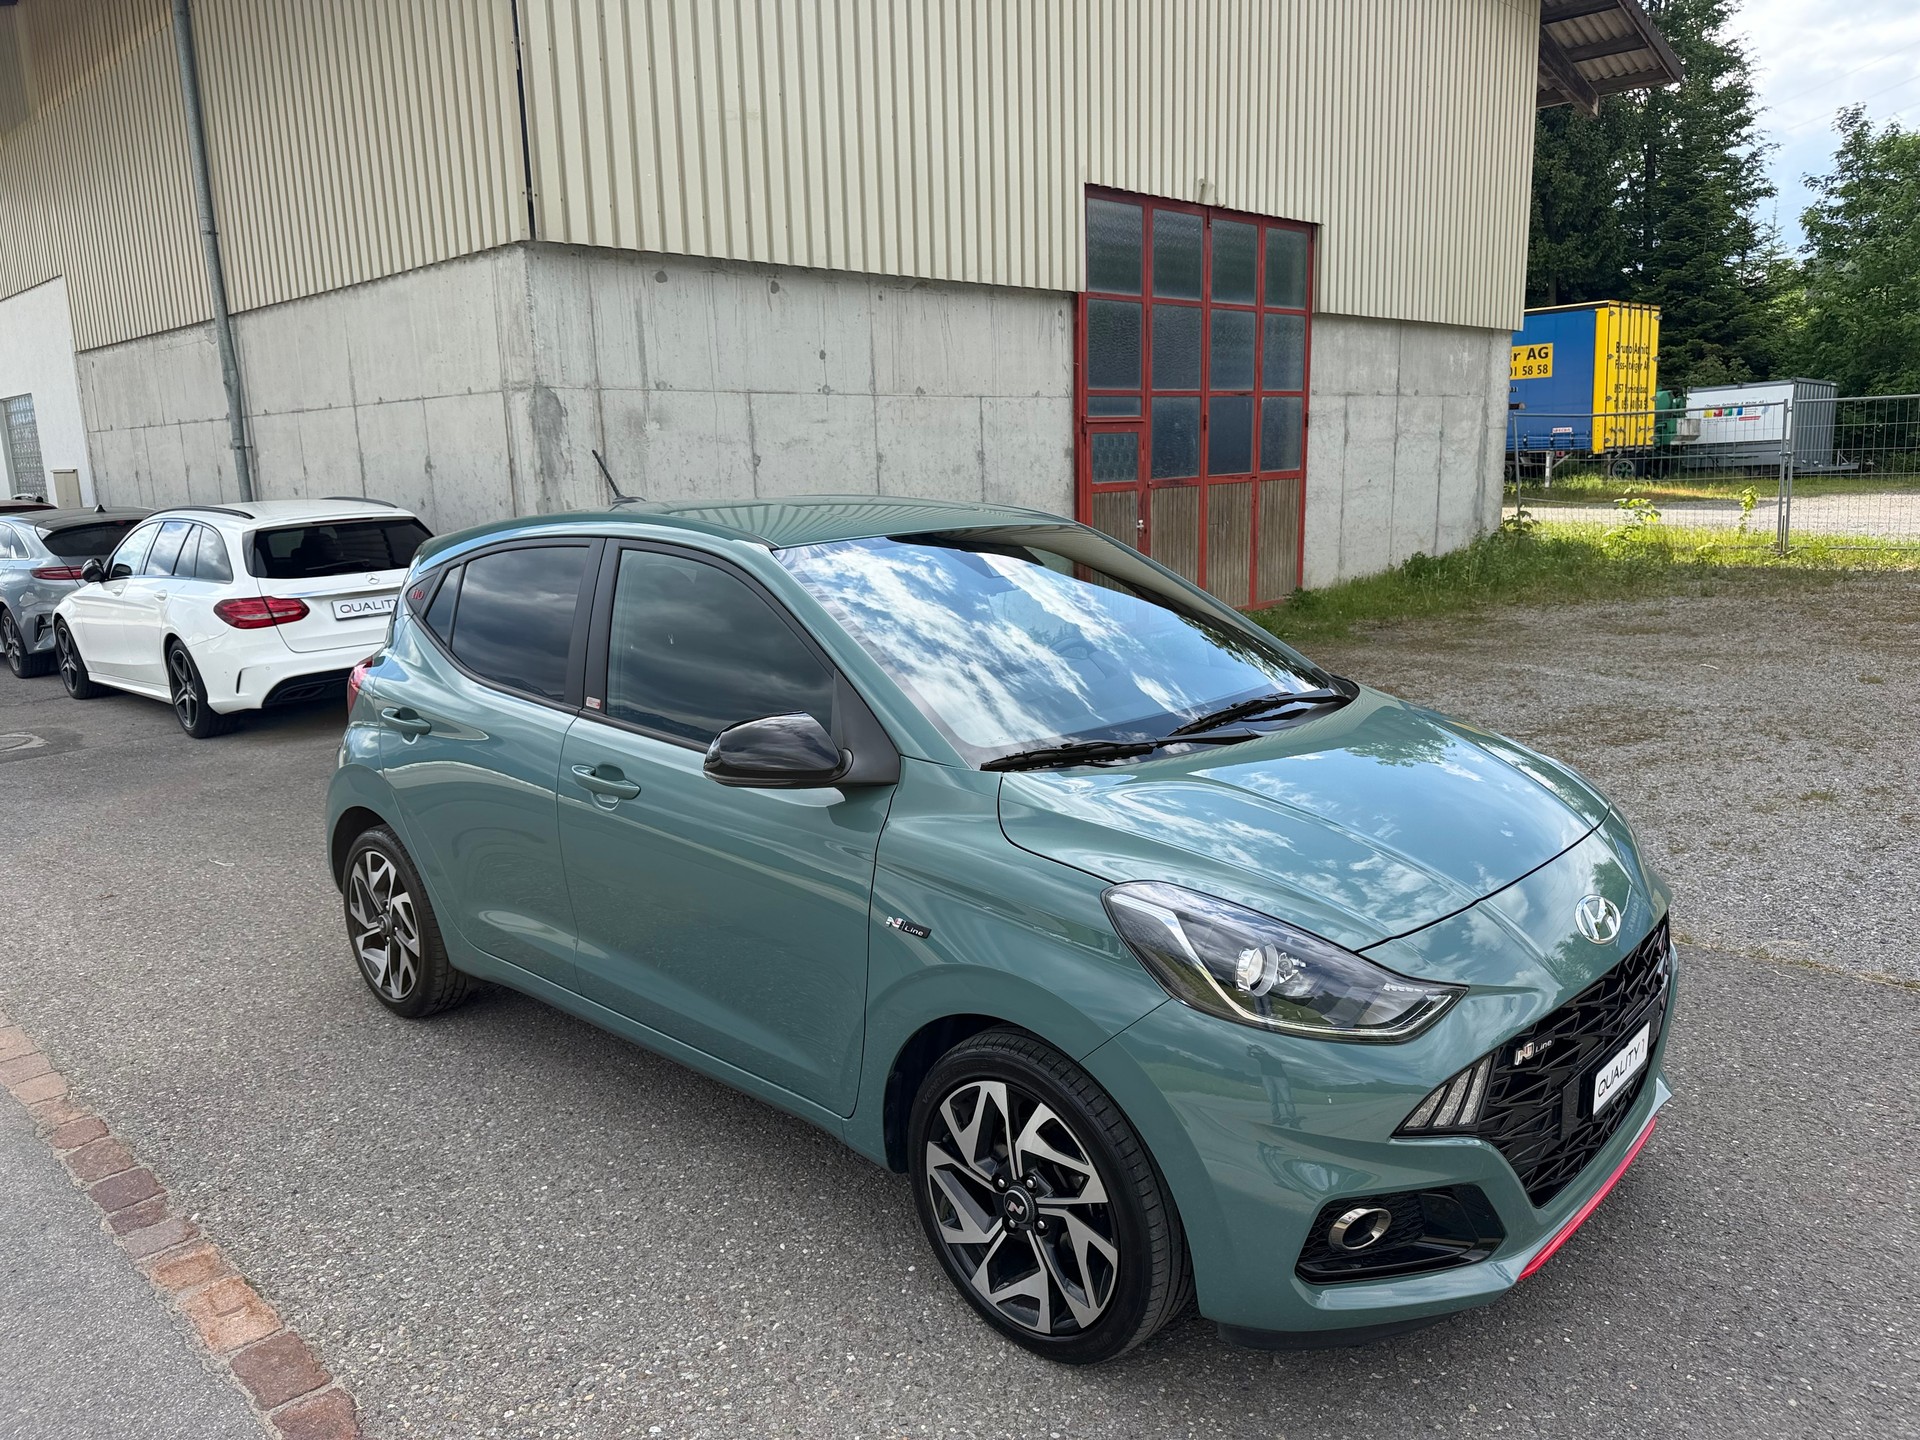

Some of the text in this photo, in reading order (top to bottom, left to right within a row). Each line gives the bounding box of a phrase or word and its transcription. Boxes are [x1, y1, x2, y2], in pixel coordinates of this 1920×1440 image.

[1526, 346, 1549, 361] AG
[1522, 365, 1533, 376] 58
[1537, 364, 1548, 375] 58
[904, 925, 924, 936] Line
[1535, 1039, 1552, 1053] Line
[1597, 1042, 1641, 1098] QUALITY
